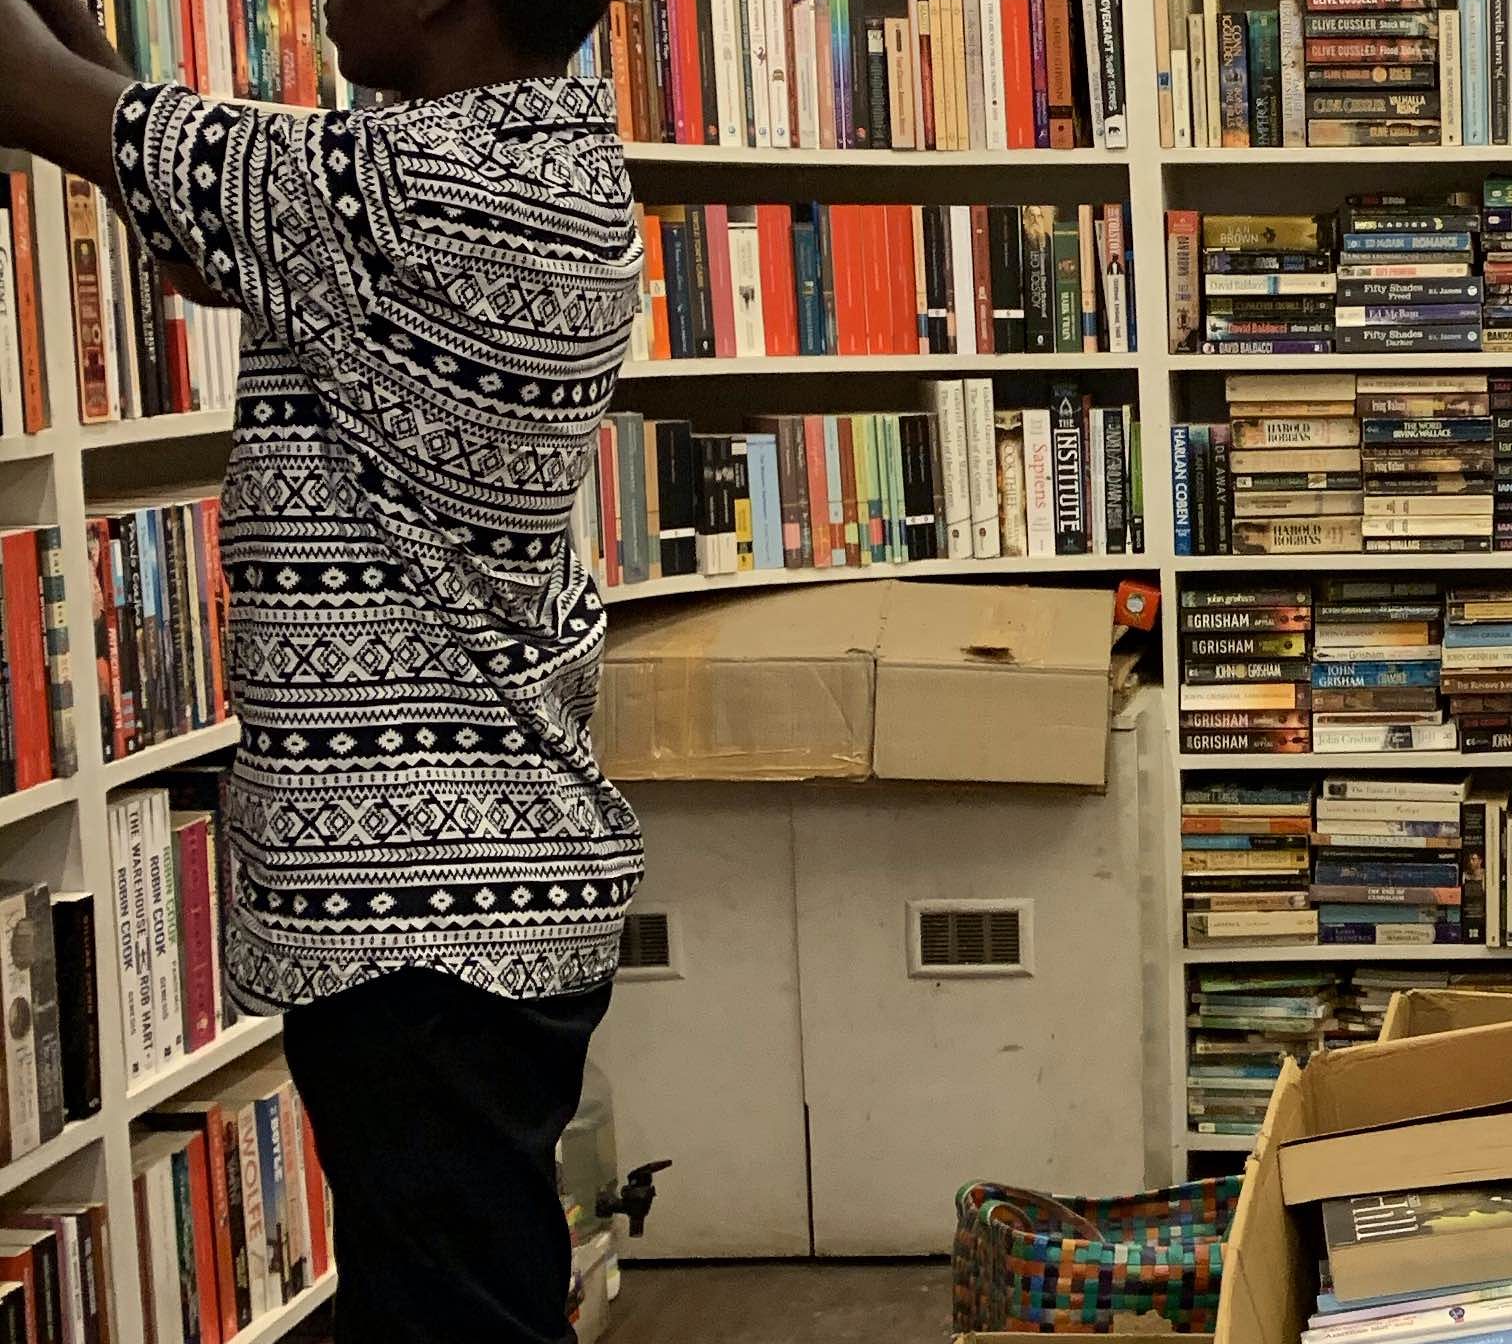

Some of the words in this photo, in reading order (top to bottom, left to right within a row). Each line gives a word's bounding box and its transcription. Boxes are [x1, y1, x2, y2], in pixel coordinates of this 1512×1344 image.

[1364, 284, 1386, 295] Fifty
[1389, 283, 1424, 295] Shades
[1267, 423, 1311, 434] HAROLD
[1267, 432, 1311, 443] ROBBINS
[1176, 427, 1189, 479] HARLAN
[1034, 443, 1049, 509] Sapiens
[1176, 482, 1189, 526] COBEN
[1273, 525, 1322, 536] HAROLD
[1273, 534, 1322, 546] ROBBINS
[1201, 640, 1254, 654] GRISHAM
[1327, 665, 1355, 676] JOHN
[1318, 674, 1365, 687] GRISHAM
[1194, 714, 1249, 727] GRISHAM
[1194, 735, 1249, 749] GRISHAM
[1492, 734, 1512, 747] JOHN
[128, 810, 140, 839] THE
[117, 867, 129, 920] ROBIN
[120, 921, 134, 972] COOK
